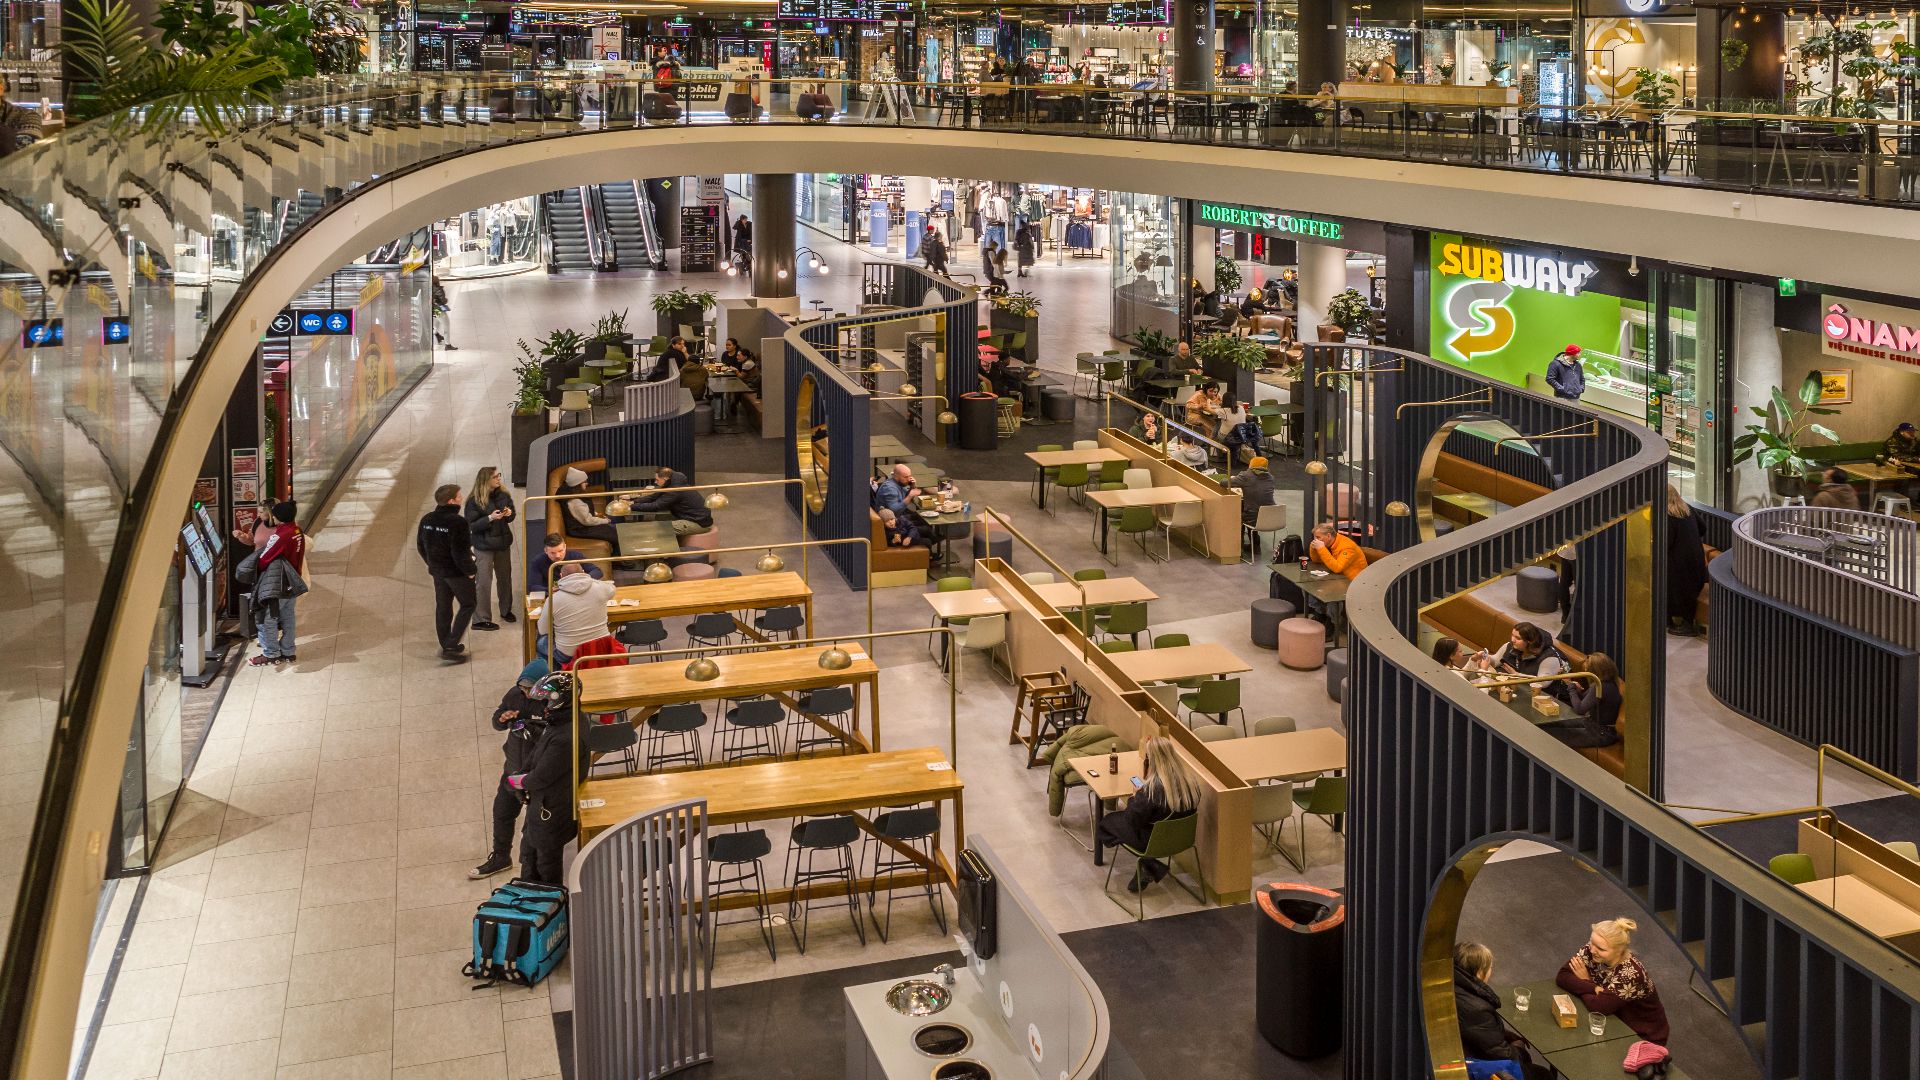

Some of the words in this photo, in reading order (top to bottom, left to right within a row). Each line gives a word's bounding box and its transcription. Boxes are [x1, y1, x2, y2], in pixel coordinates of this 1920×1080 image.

[1346, 29, 1411, 40] TUALS...
[1201, 204, 1272, 229] ROBERT'S
[1277, 214, 1341, 240] COFFEE
[1438, 243, 1598, 296] SUBWAY
